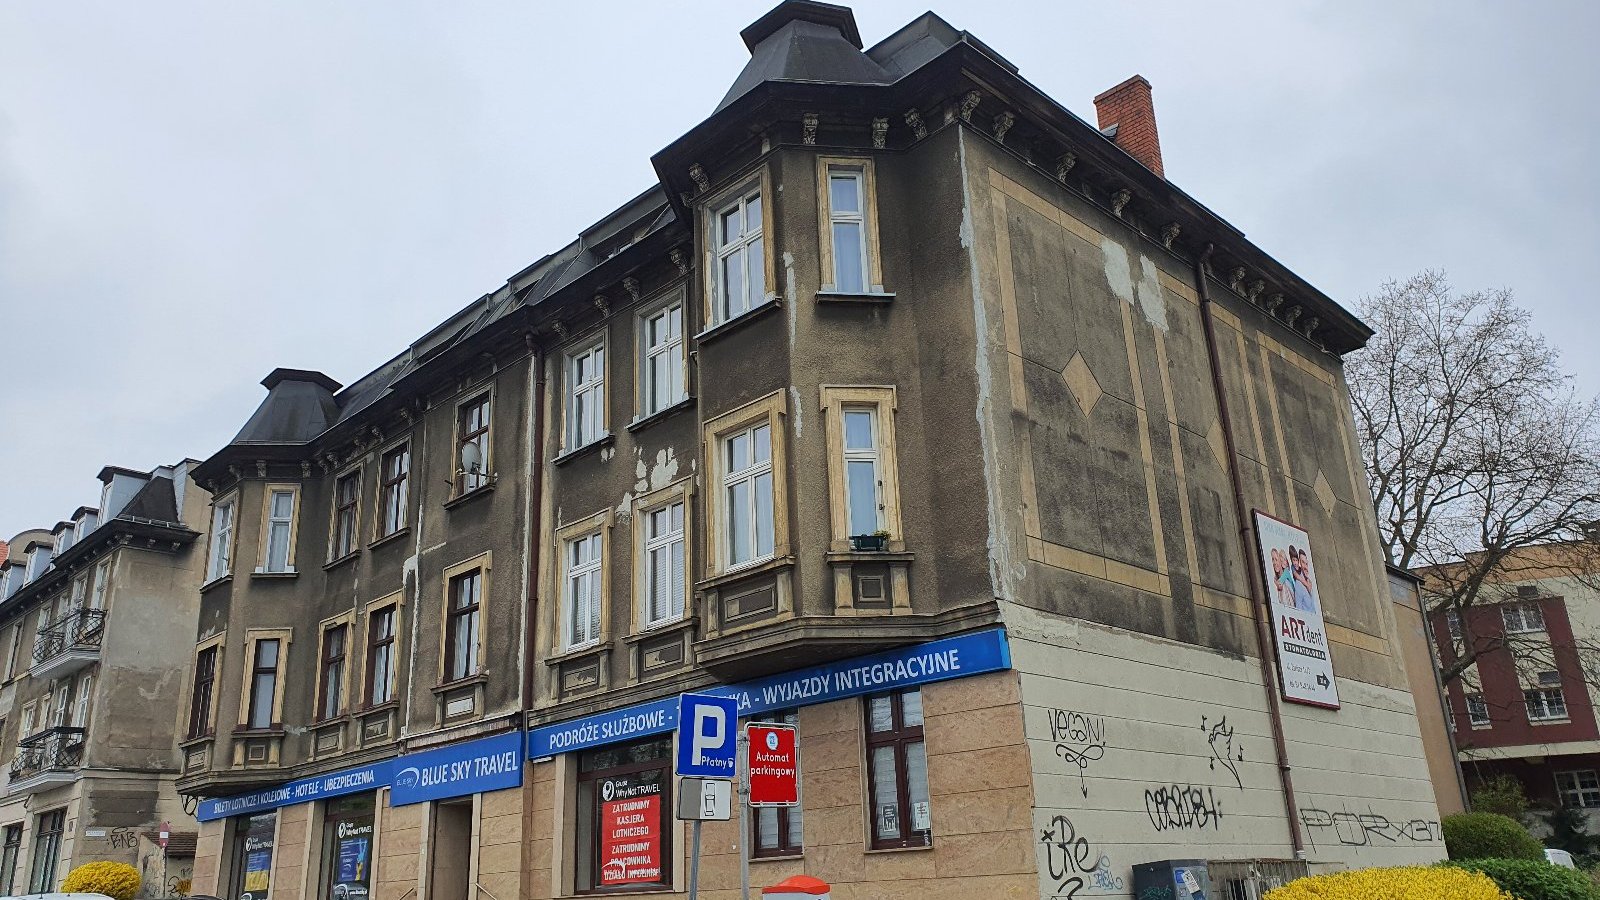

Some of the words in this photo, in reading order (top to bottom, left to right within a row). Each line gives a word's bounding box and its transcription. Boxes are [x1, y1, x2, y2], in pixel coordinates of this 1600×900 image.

[762, 673, 830, 705] WYJAZDY
[834, 648, 960, 692] INTEGRACYJNE
[549, 721, 599, 750] PODRÓŻE
[601, 709, 665, 739] SŁUŻBOWE
[691, 703, 726, 766] P
[701, 755, 727, 770] Płatny
[755, 751, 790, 763] Automat
[421, 764, 449, 787] BLUE
[450, 759, 472, 782] SKY
[474, 750, 519, 777] TRAVEL
[750, 765, 796, 779] parkingowy
[293, 781, 320, 798] HOTELE
[324, 769, 375, 792] UBEZPIECZENIA
[612, 800, 650, 814] ZATRUDNIMY
[616, 813, 645, 826] KASJERA
[612, 826, 649, 839] LOTNICZEGO
[611, 841, 651, 855] ZATRUDNIMY
